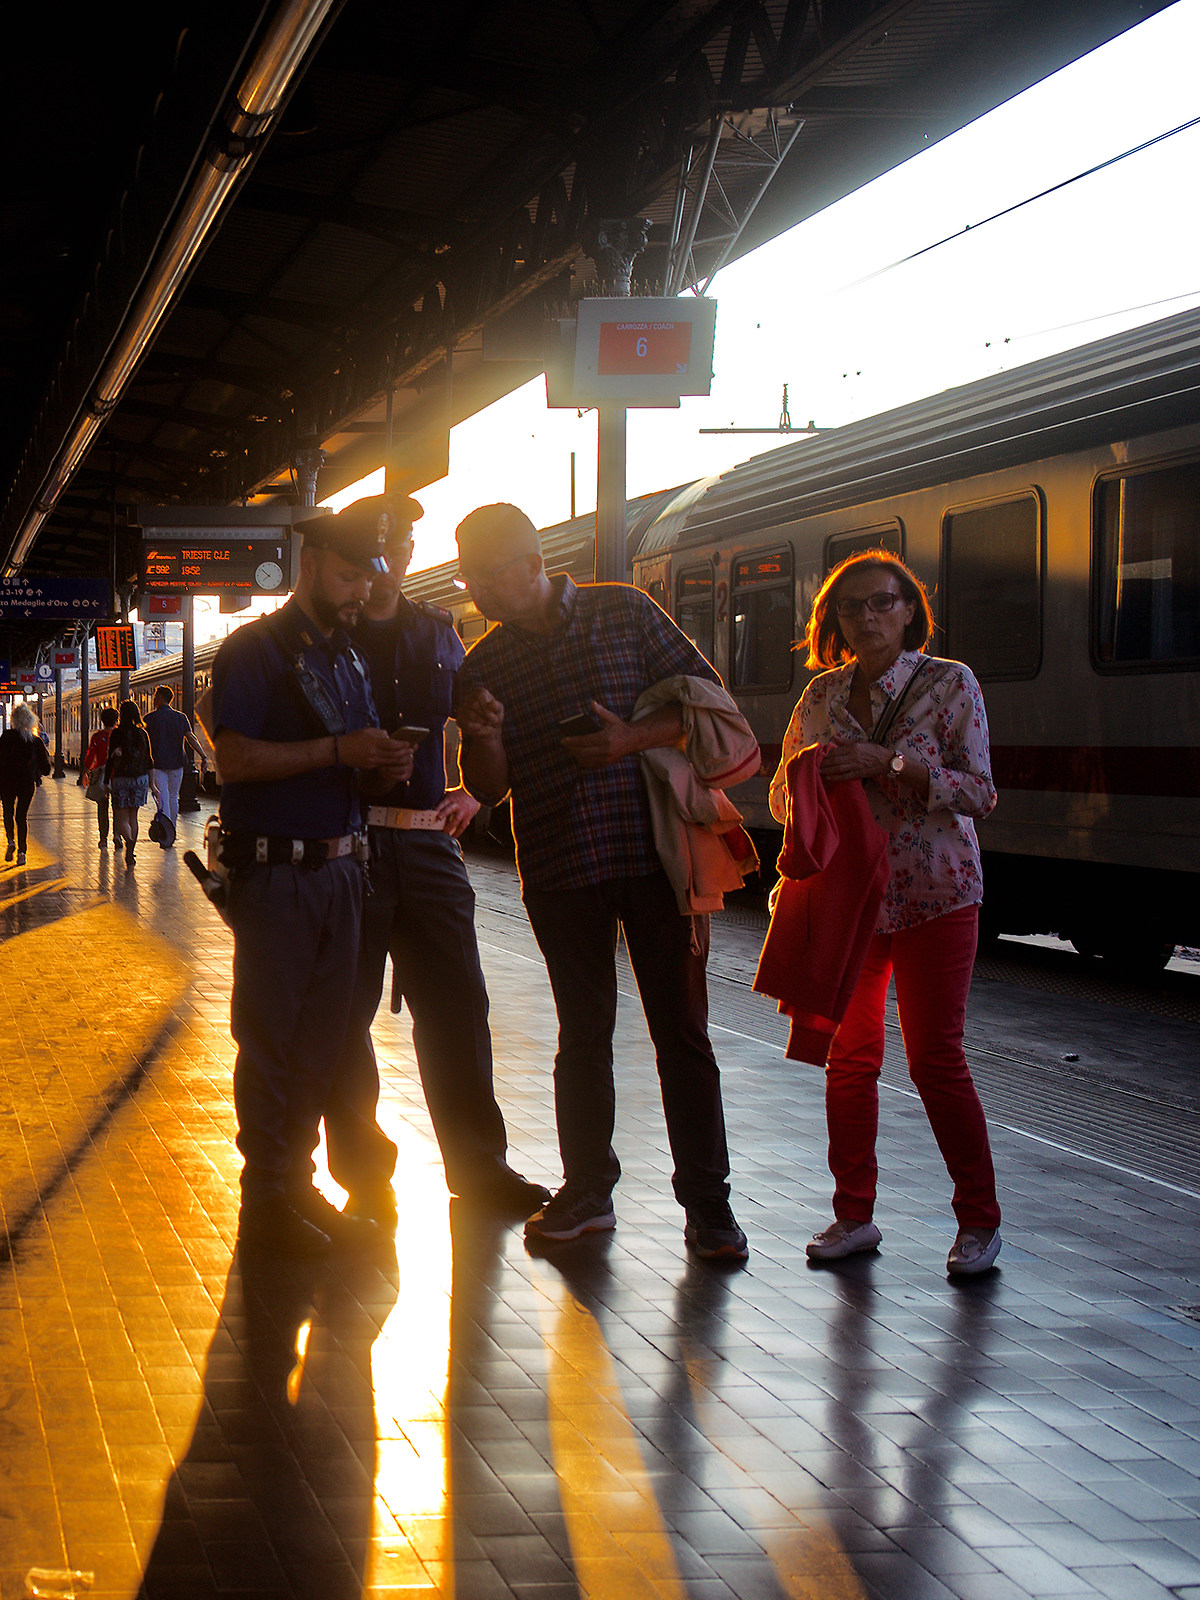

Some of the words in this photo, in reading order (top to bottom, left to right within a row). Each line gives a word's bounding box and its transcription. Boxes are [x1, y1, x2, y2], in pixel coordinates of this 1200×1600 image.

[616, 322, 648, 330] CARROZZA
[653, 322, 674, 330] COACH
[636, 337, 648, 357] 6
[181, 550, 211, 560] TRIESTE
[276, 547, 282, 559] 1
[156, 564, 170, 574] 592
[10, 600, 46, 608] Medaglie
[161, 600, 167, 609] 5
